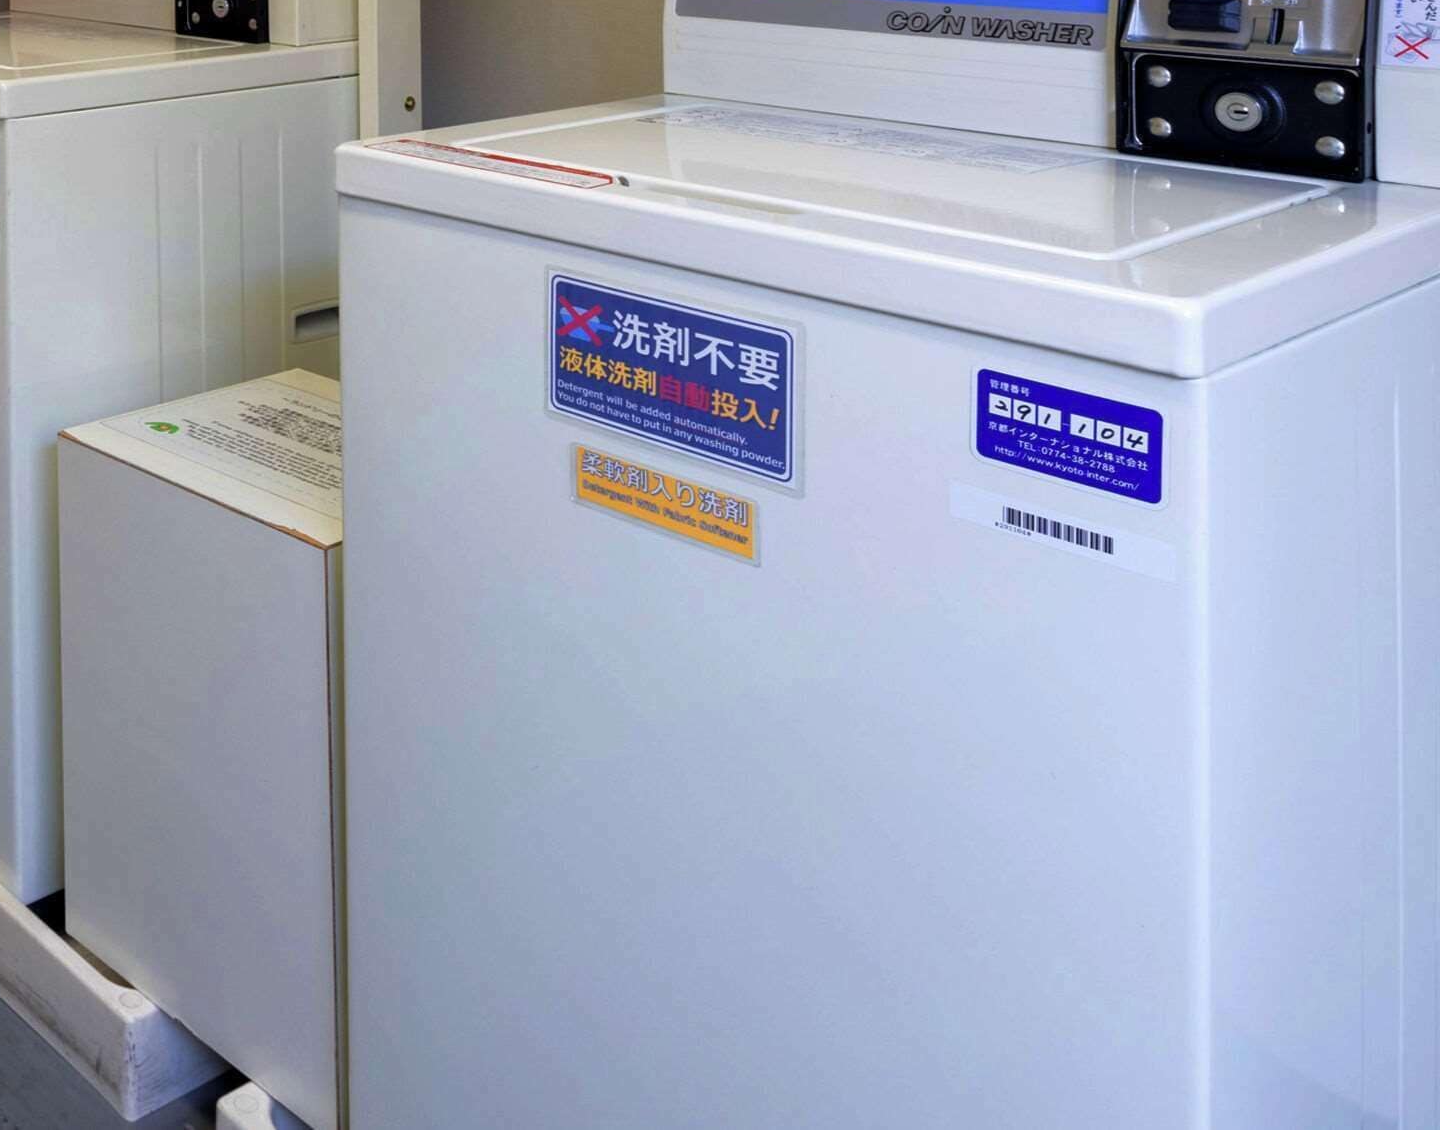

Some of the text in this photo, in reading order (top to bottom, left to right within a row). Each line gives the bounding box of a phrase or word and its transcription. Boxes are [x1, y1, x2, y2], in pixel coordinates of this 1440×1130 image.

[971, 16, 1093, 46] WASHER
[612, 309, 780, 391] 洗剤不要
[557, 379, 749, 446] Detergent will be added automatically.
[560, 345, 781, 430] 液体洗剤自動投入!
[989, 379, 1030, 397] 管理番号
[557, 391, 786, 469] You do not have to put in any washing powder.
[988, 421, 1149, 471] 京都インターナショナル株式会社
[582, 452, 748, 527] 柔軟剤入り洗剤
[582, 479, 632, 505] Detergent
